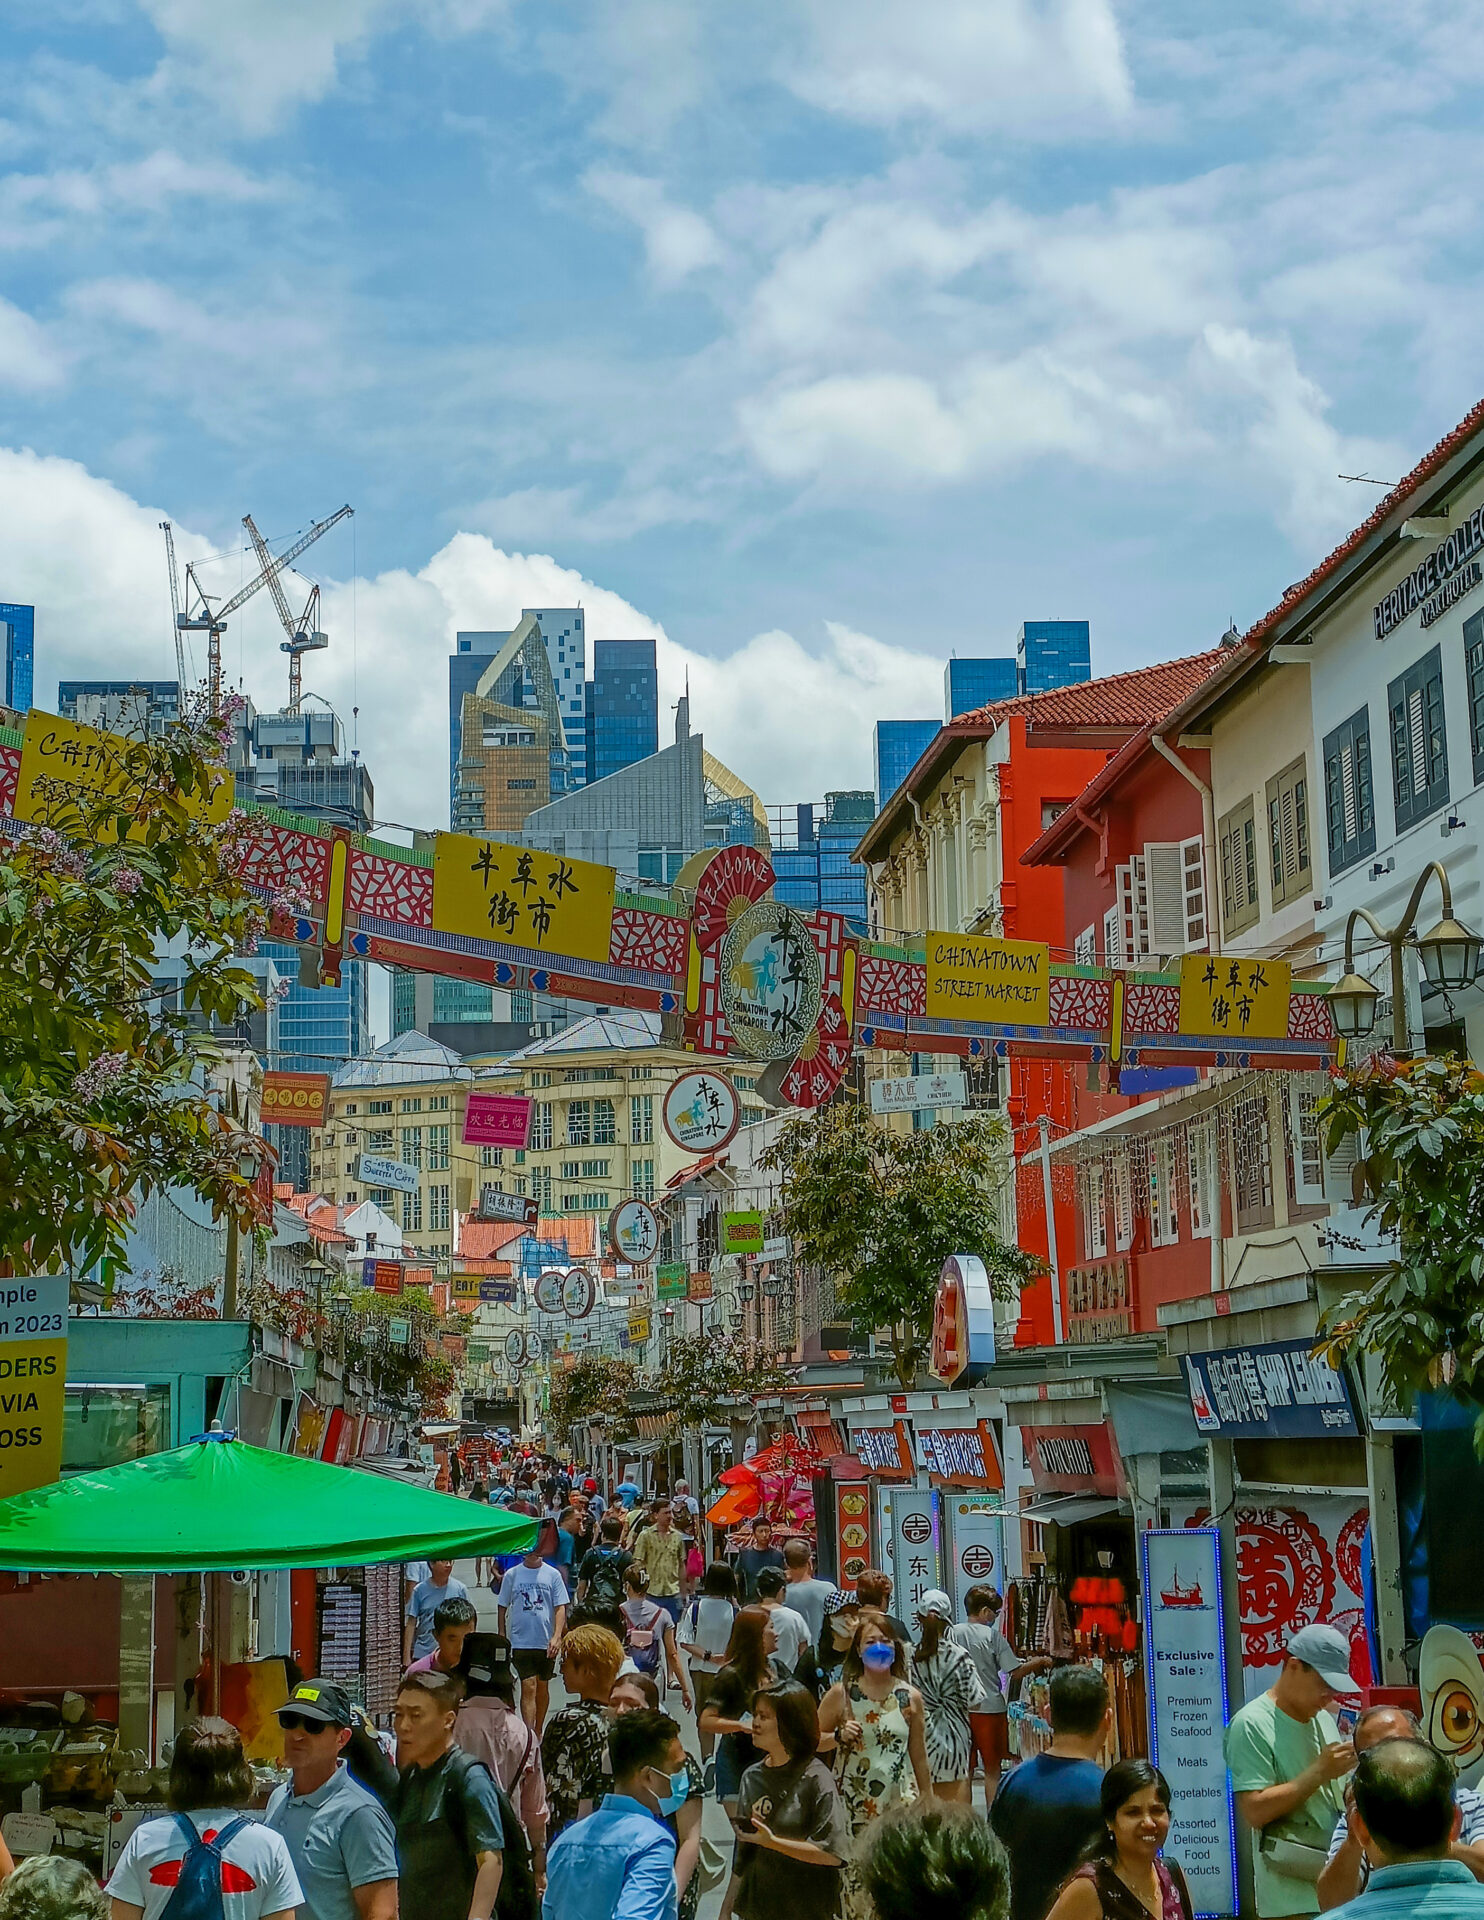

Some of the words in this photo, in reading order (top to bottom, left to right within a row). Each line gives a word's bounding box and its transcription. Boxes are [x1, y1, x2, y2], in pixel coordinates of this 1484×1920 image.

[1374, 556, 1436, 637] HERITAGE
[471, 843, 580, 900] 牛车水
[697, 856, 769, 934] WELCOME
[488, 892, 557, 945] 街市
[934, 943, 1041, 974] CHINATOWN
[934, 977, 983, 998] STREET
[985, 986, 1041, 1003] MARKET
[733, 1001, 769, 1018] CHINATOWN
[1211, 994, 1255, 1032] 街市
[731, 1014, 768, 1030] SINGAPORE
[455, 1279, 475, 1292] EAT
[14, 1314, 63, 1333] 2023
[0, 1356, 57, 1378] DERS
[1256, 1353, 1292, 1407] SHIP
[0, 1392, 39, 1413] VIA
[0, 1427, 42, 1448] OSS
[1156, 1650, 1215, 1661] Exclusive
[1169, 1665, 1195, 1676] Sale
[1167, 1696, 1212, 1706] Premium
[1173, 1711, 1208, 1722] Frozen
[1170, 1726, 1212, 1737] Seafood
[1177, 1757, 1208, 1768] Meats
[1172, 1818, 1217, 1829] Assorted
[1174, 1834, 1220, 1845] Delicious
[1184, 1849, 1210, 1860] Food
[1183, 1865, 1221, 1876] roducts
